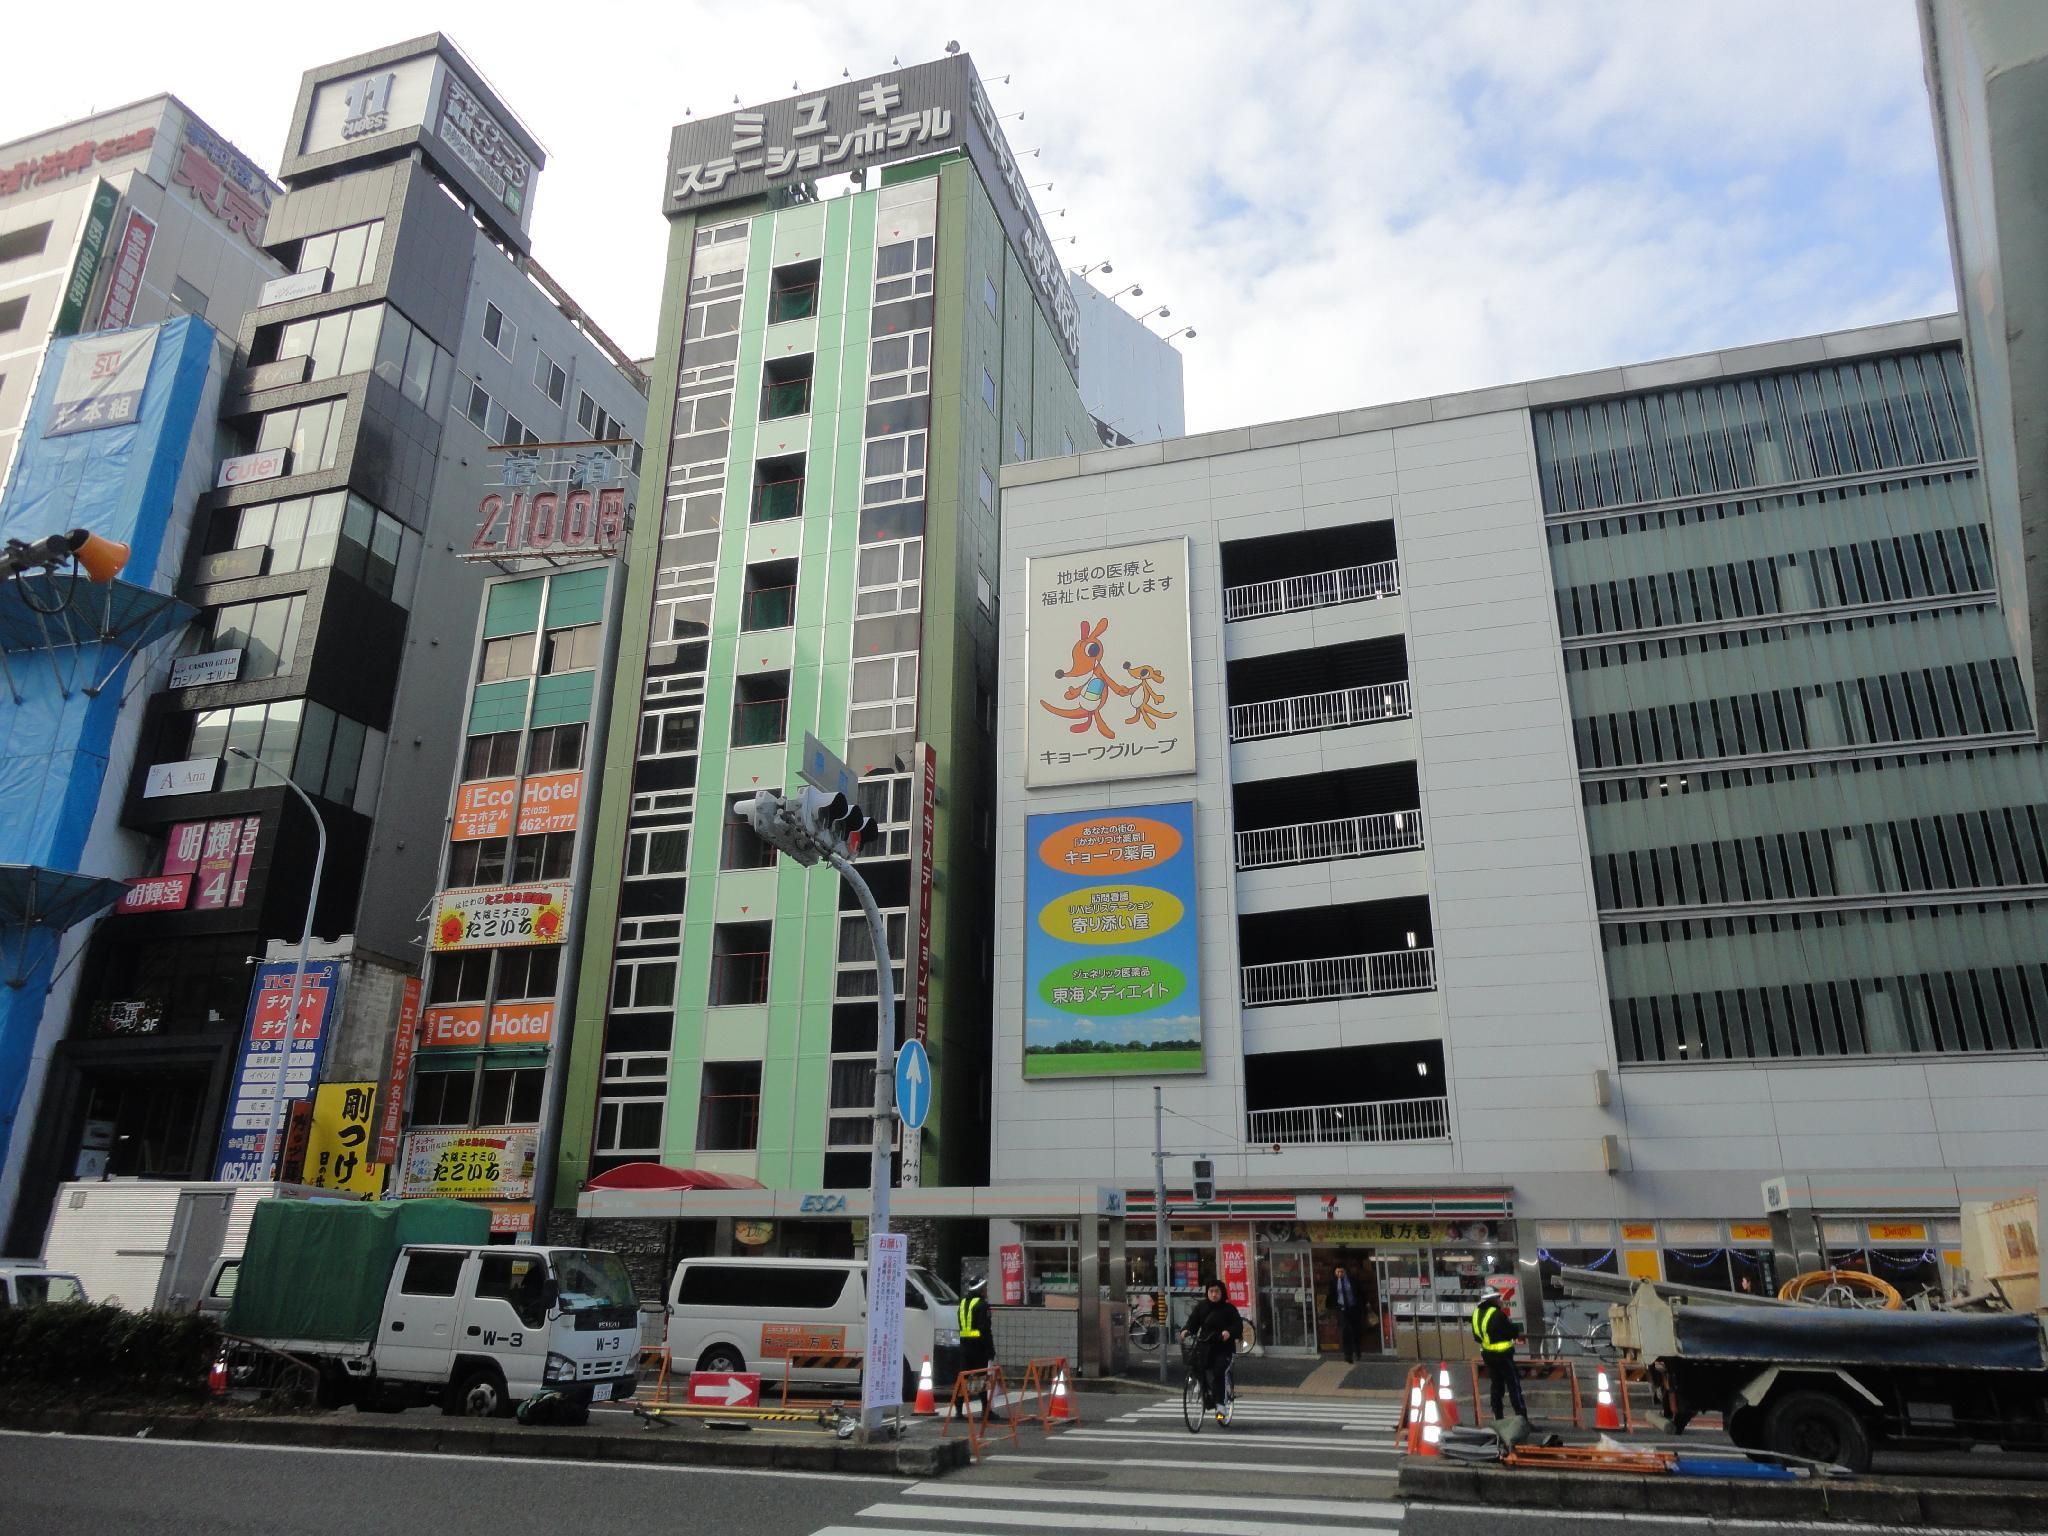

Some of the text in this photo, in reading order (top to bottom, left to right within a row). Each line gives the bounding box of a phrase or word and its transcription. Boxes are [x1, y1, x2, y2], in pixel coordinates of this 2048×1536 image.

[345, 73, 396, 121] 11
[732, 82, 901, 151] ミユキ
[673, 106, 951, 200] ステーションホテル
[1057, 559, 1155, 585] 地域の医療と
[1041, 576, 1174, 607] 福祉に貢献します
[1040, 737, 1178, 765] キョーワグループ
[473, 778, 579, 808] Eco Hotel
[458, 809, 508, 824] エコホテル
[520, 813, 576, 832] 462-1777
[467, 822, 497, 835] 名古屋
[1083, 824, 1136, 836] あなたの街の
[177, 817, 260, 862] 明輝堂
[1065, 844, 1157, 865] キョーワ薬局
[126, 880, 183, 907] 明輝堂
[203, 872, 248, 903] 4F
[1068, 901, 1153, 915] リハビリステーション
[465, 917, 533, 939] たこいち
[1072, 913, 1149, 934] 寄り添い屋
[264, 973, 322, 989] TICET
[1072, 966, 1151, 980] ジェネリック医薬品
[266, 994, 317, 1009] チケト
[1052, 983, 1170, 1004] 東海メディエイト
[261, 1018, 312, 1034] チケト
[437, 1010, 550, 1039] Eco Hotel
[391, 1007, 413, 1081] エコホテル
[384, 1085, 402, 1132] 名古屋
[432, 1162, 500, 1181] たこいち
[800, 1194, 847, 1213] ESCA
[483, 1330, 524, 1348] W-3
[596, 1336, 620, 1352] W-3
